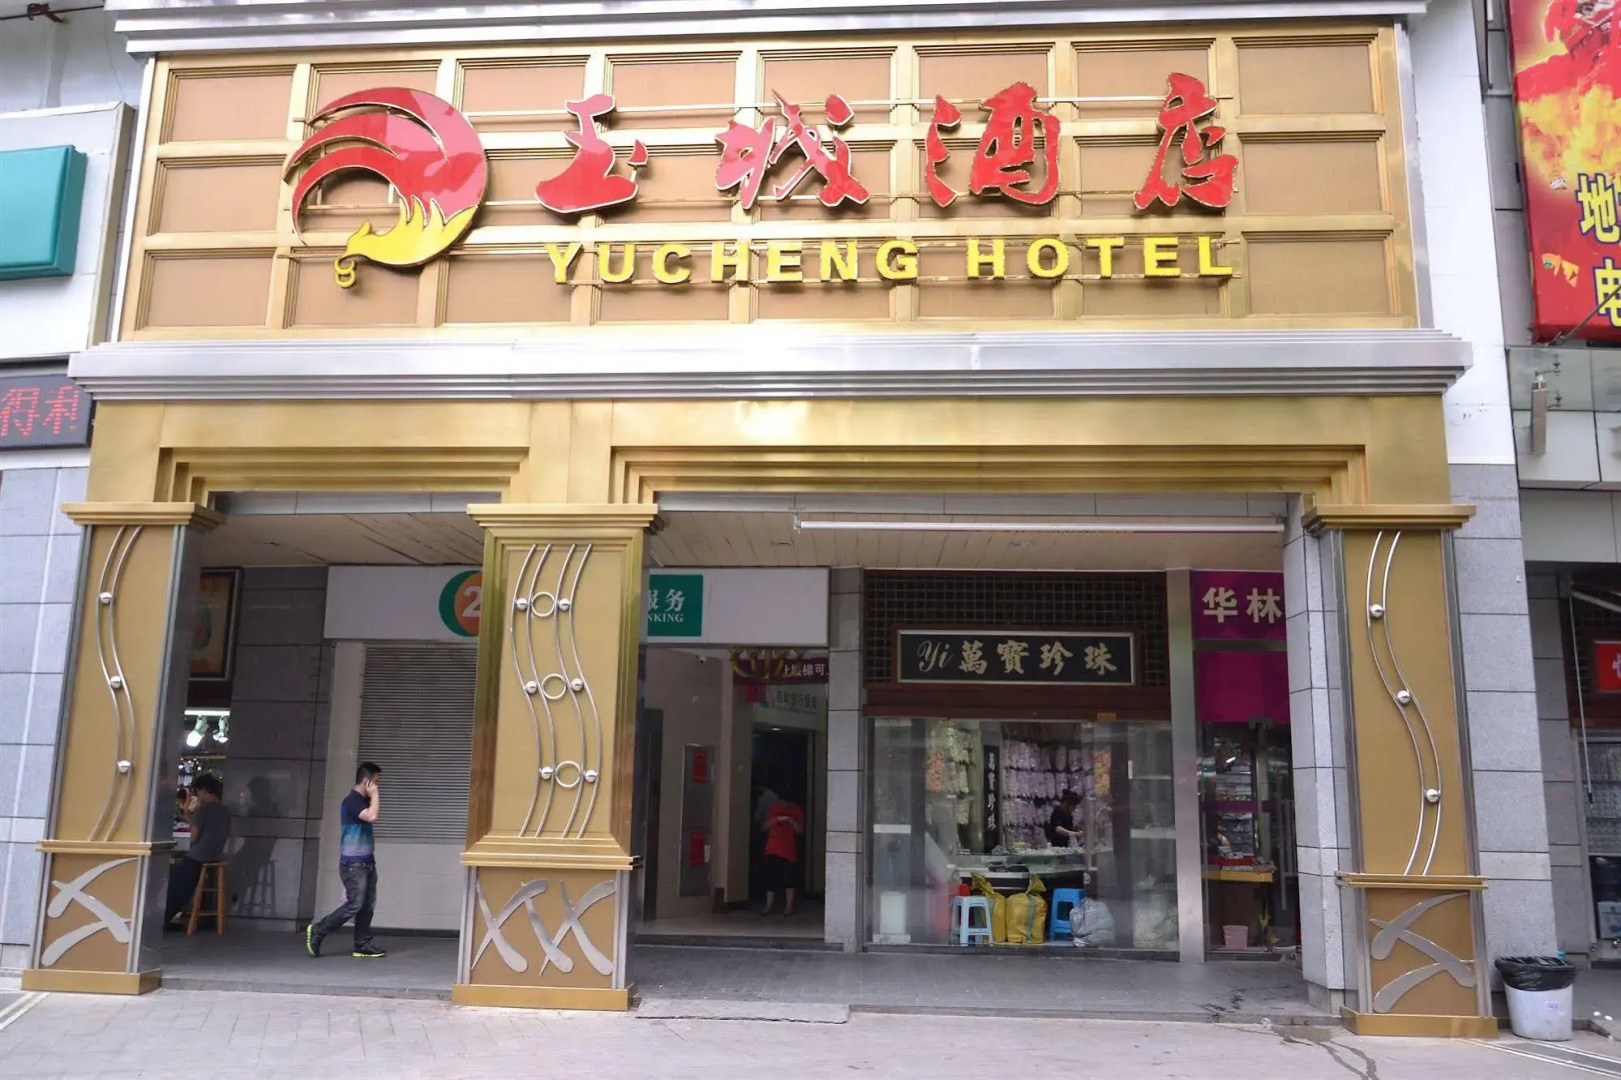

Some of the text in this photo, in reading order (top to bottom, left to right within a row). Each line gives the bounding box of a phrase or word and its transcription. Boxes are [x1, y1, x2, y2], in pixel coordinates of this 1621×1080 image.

[535, 72, 1238, 214] 玉城酒店
[1576, 172, 1621, 244] 地
[544, 236, 1232, 284] YUCHENG HOTEL
[1202, 587, 1282, 623] 华林
